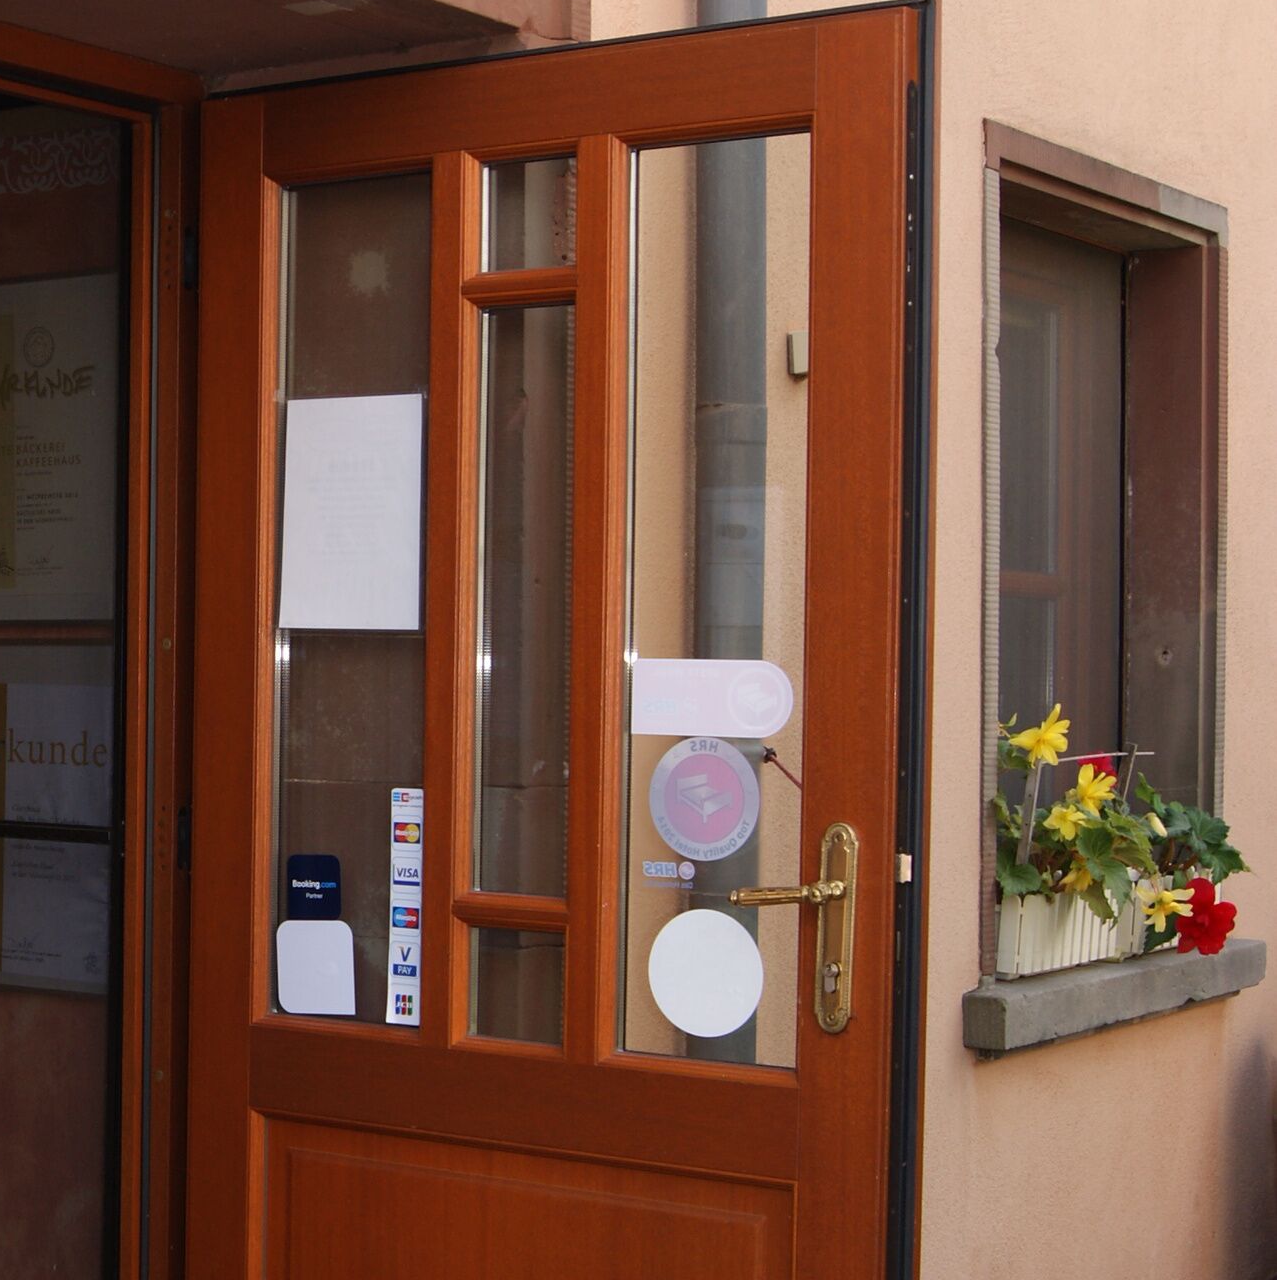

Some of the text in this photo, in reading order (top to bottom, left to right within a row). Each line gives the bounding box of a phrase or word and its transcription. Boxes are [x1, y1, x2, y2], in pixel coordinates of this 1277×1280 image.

[396, 868, 419, 878] VISA
[292, 879, 337, 891] Booking.com
[397, 966, 412, 975] PAY
